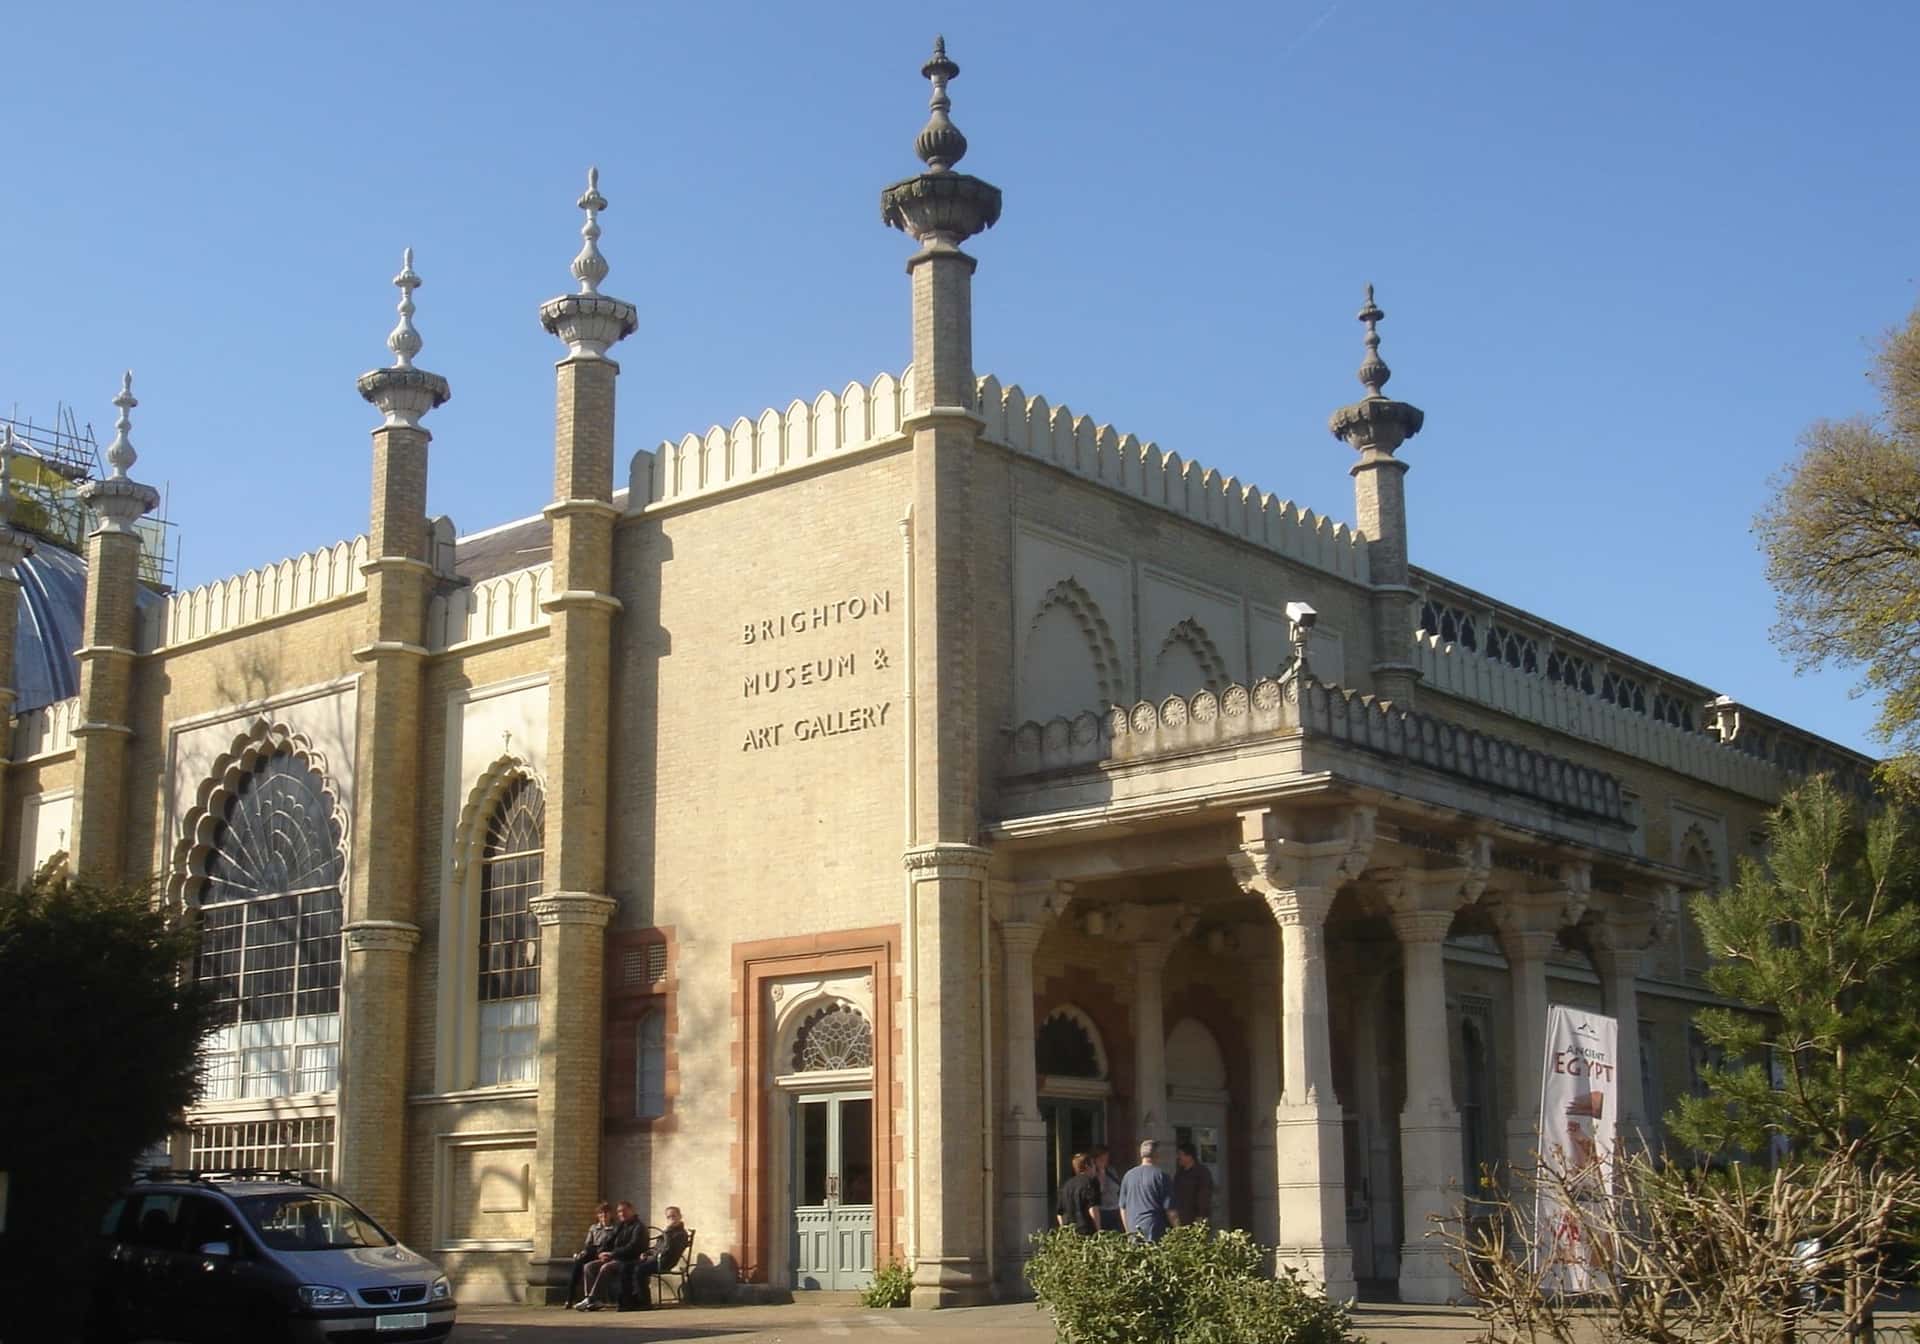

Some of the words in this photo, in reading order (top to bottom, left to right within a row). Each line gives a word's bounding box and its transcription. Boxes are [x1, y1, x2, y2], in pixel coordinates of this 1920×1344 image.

[743, 590, 890, 645] BRIGHTON
[743, 653, 855, 698] MUSEUM
[874, 647, 891, 670] &
[743, 723, 784, 752] ART
[794, 702, 891, 741] GALLERY
[1554, 1052, 1614, 1083] EGYPT
[1566, 1045, 1605, 1060] ANCIENT
